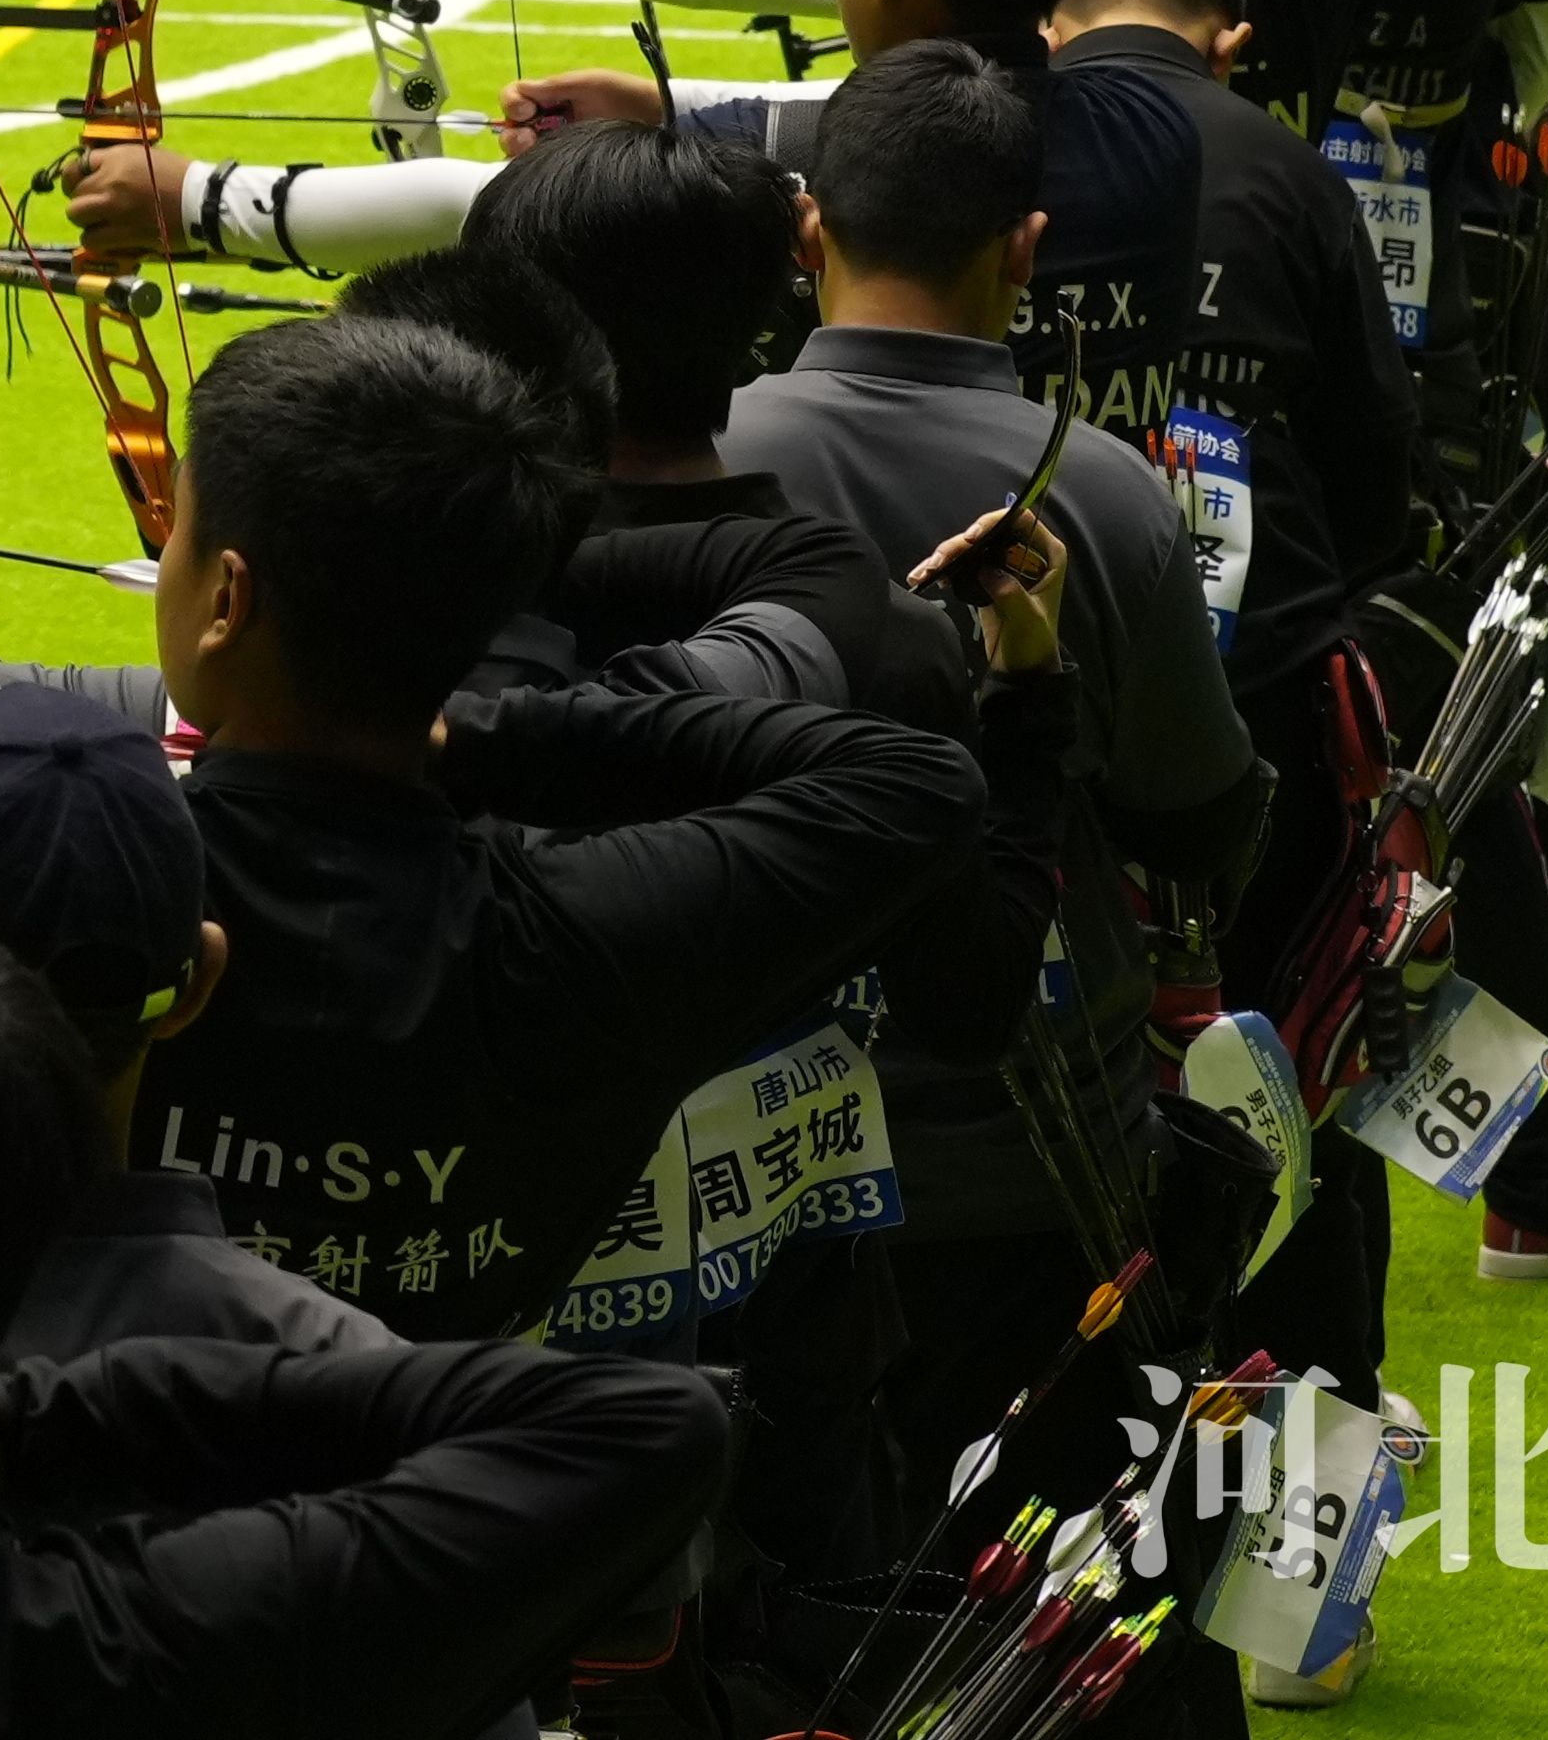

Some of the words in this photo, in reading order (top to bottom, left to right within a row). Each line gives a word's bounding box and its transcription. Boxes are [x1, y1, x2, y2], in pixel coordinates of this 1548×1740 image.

[1165, 423, 1241, 465] 箭协会
[751, 1045, 851, 1118] 唐山市
[1391, 1053, 1454, 1120] 男子乙组
[1415, 1077, 1492, 1159] 6B
[691, 1092, 865, 1234] 周宝城
[1264, 1483, 1348, 1590] 5B
